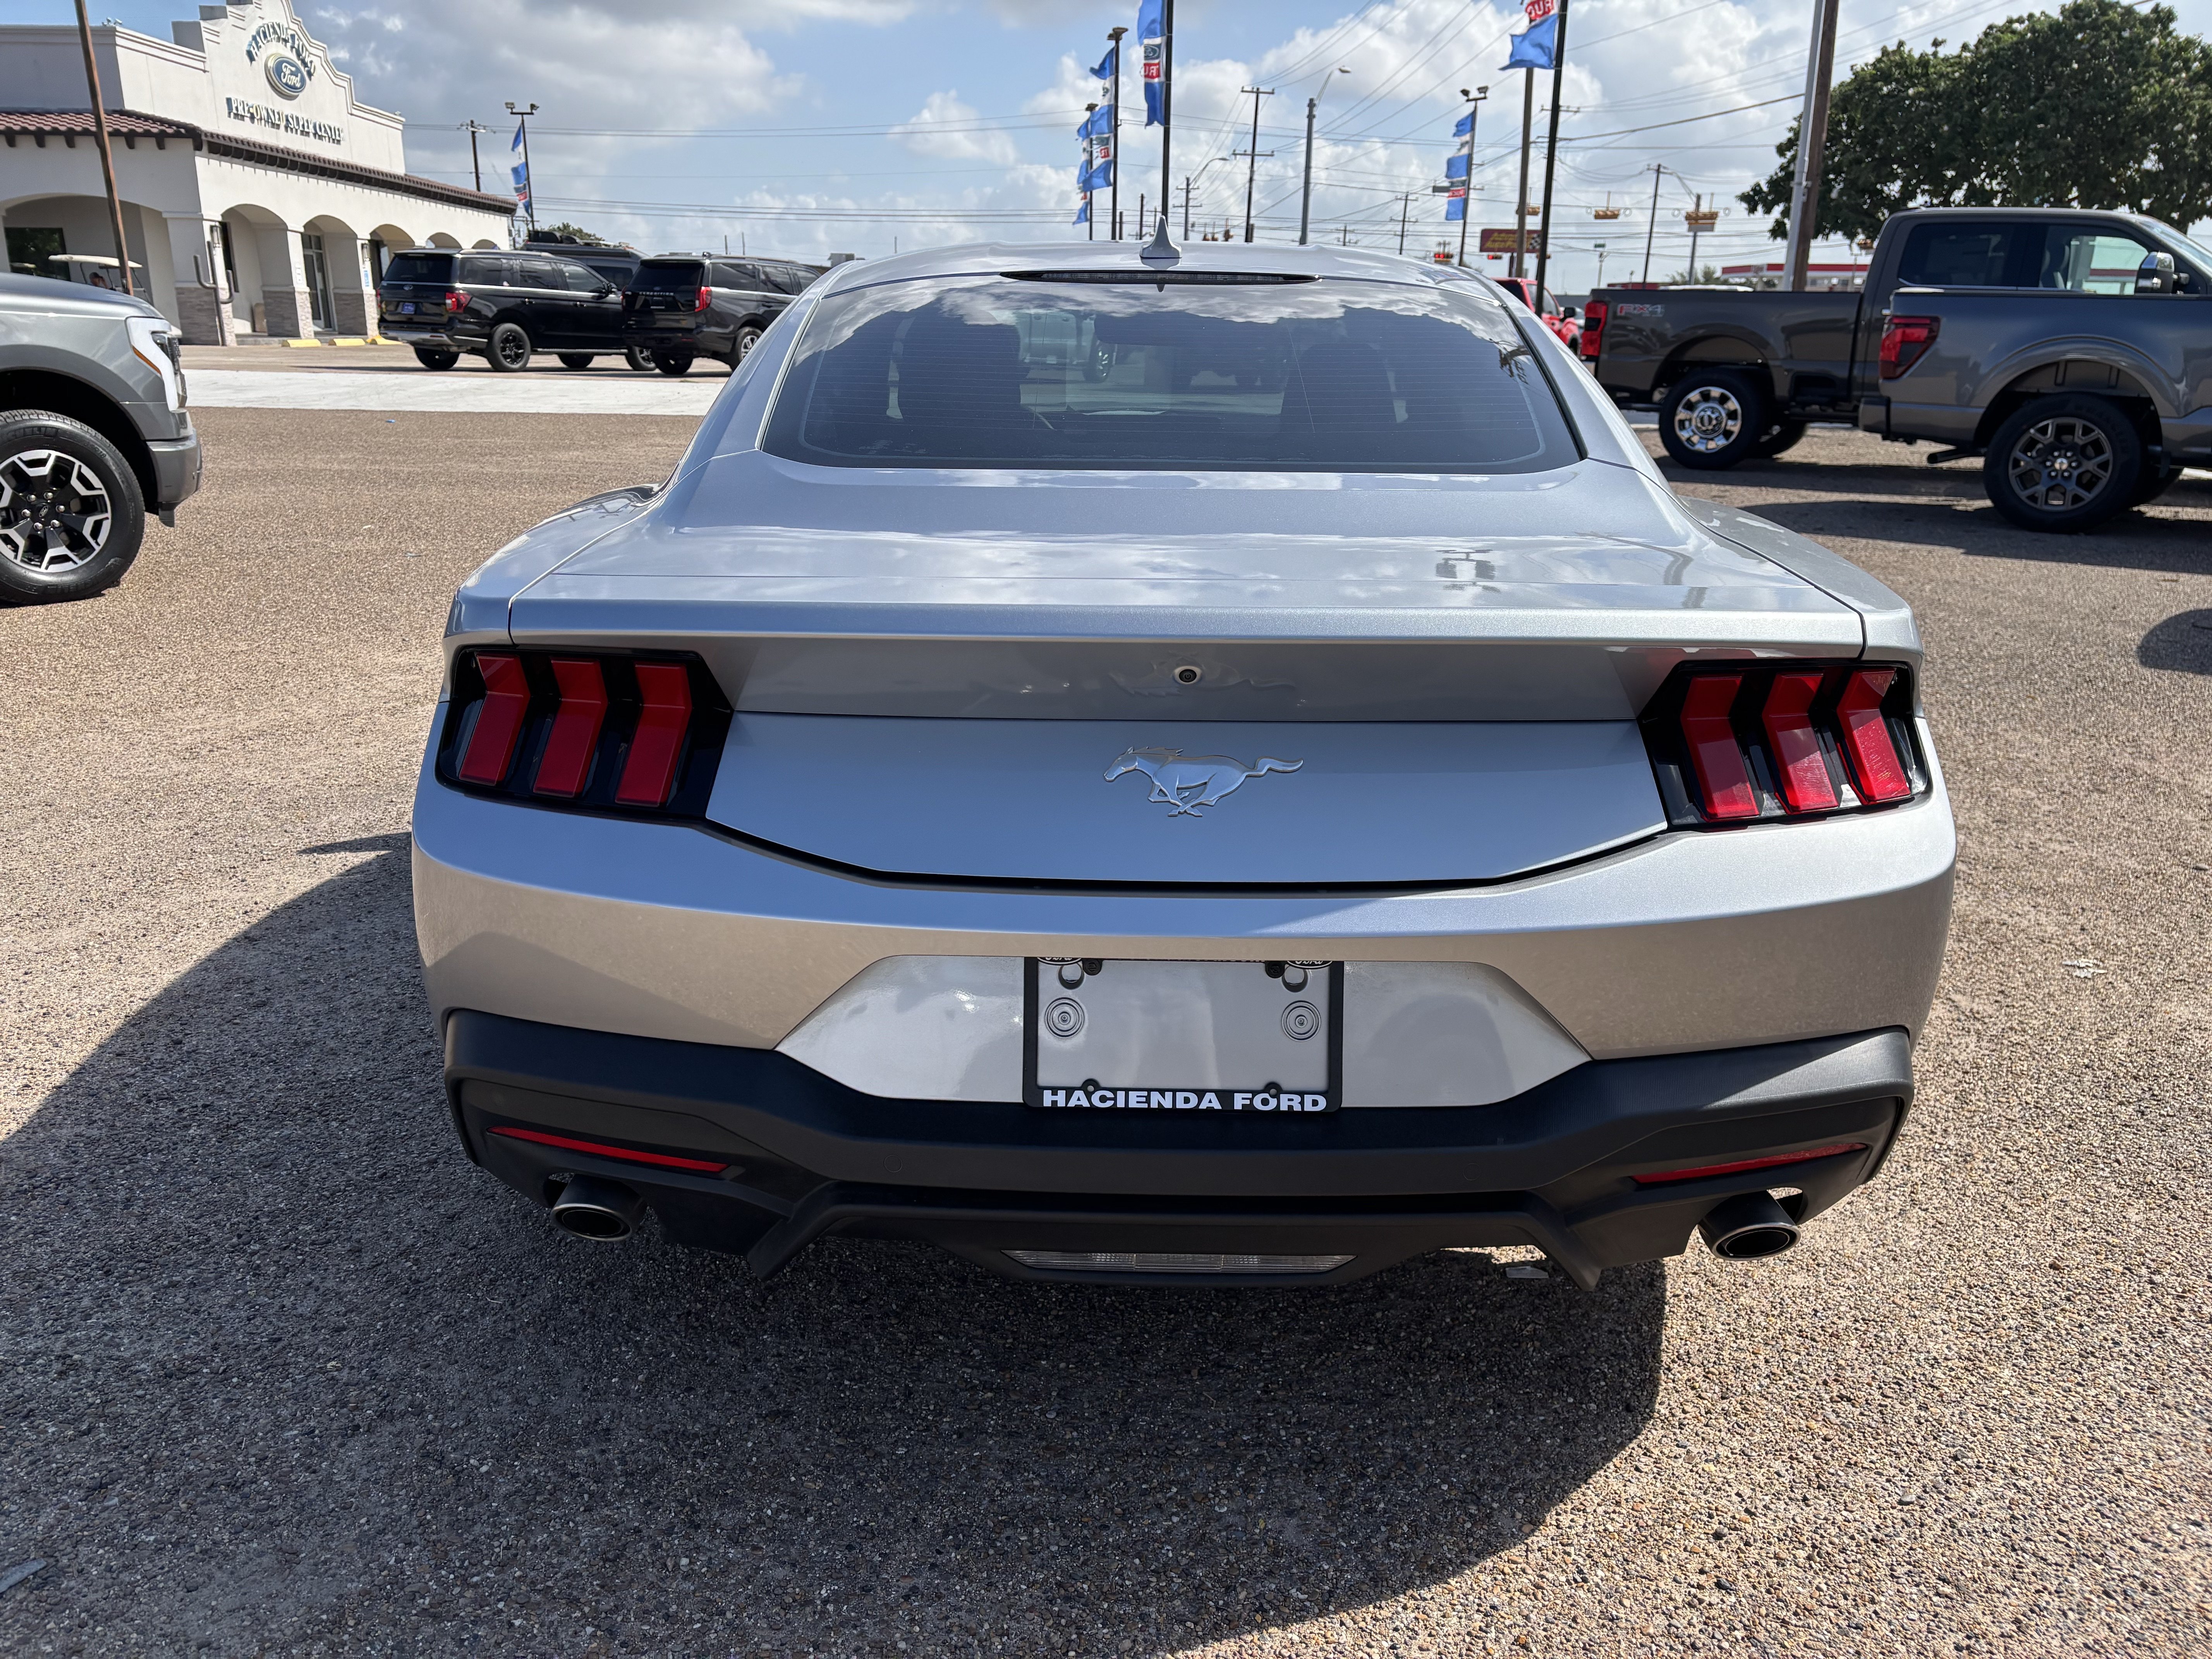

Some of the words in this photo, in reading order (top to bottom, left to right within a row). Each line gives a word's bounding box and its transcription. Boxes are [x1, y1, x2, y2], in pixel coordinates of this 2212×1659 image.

[249, 22, 291, 59] HACIENDA
[293, 35, 316, 77] FORD
[281, 62, 301, 88] Ford
[231, 98, 286, 126] PRE-OWNED
[288, 113, 316, 134] SUPER
[315, 120, 345, 142] CENTER
[1617, 304, 1662, 316] FX4
[1042, 1090, 1222, 1109] HACIENDA
[1234, 1093, 1327, 1112] FORD
